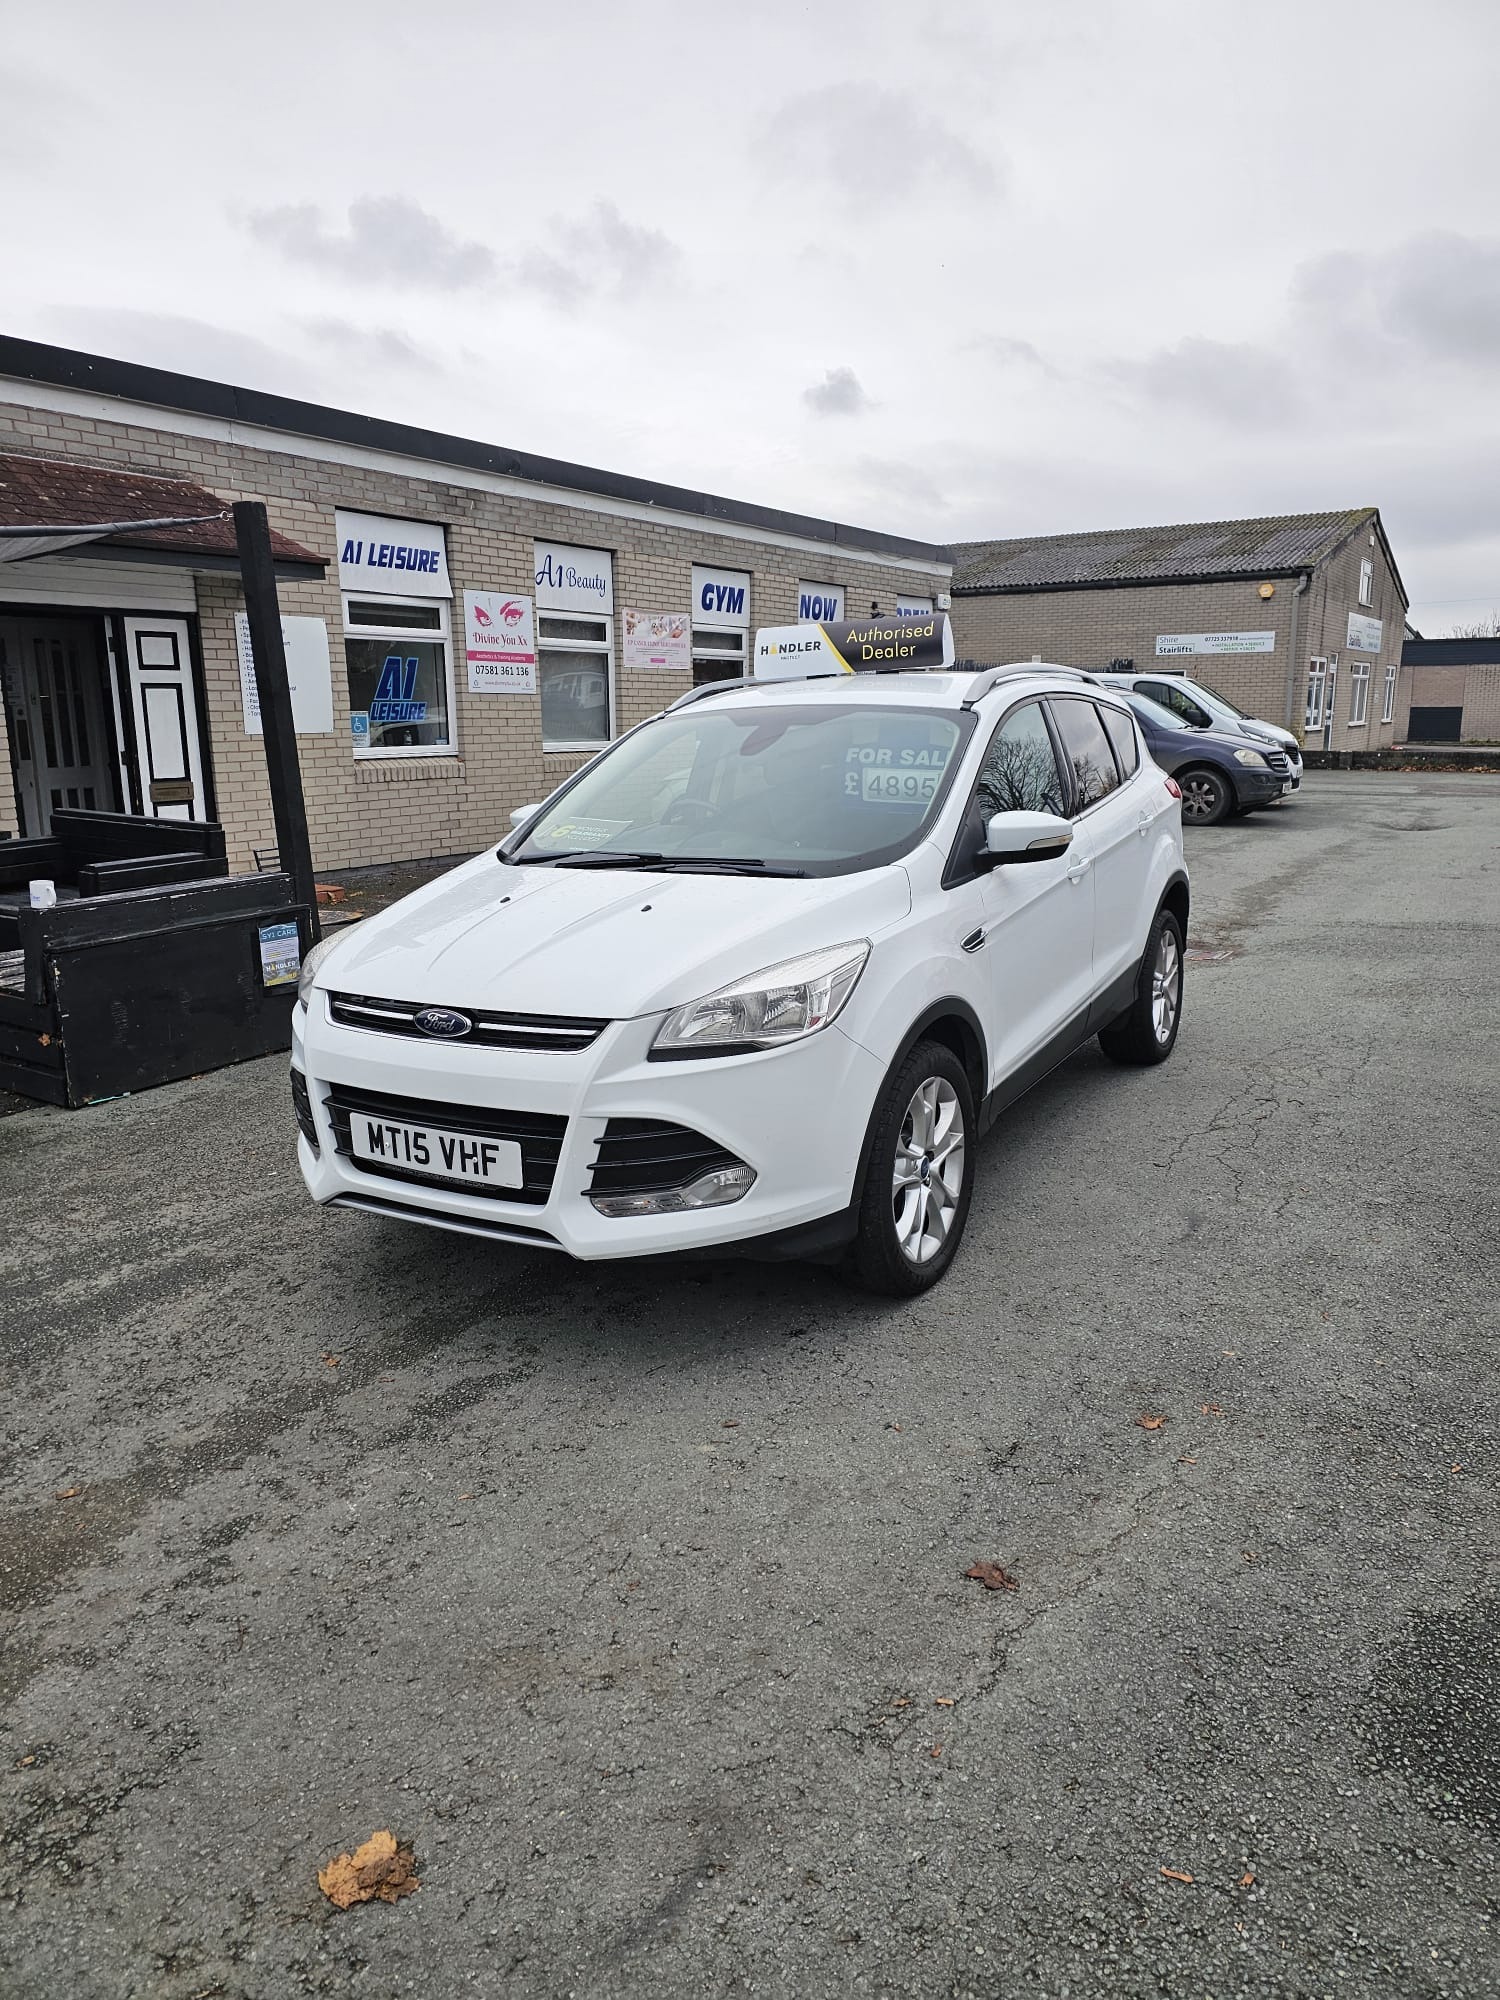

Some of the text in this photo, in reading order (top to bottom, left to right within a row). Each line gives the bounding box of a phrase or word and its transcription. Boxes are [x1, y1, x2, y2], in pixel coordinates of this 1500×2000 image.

[367, 542, 441, 574] LEISURE
[535, 554, 606, 598] A1 Beauty
[701, 583, 745, 614] GYM
[800, 594, 838, 622] NOW
[472, 632, 499, 645] Divine
[501, 633, 516, 648] You
[846, 620, 934, 644] Authorised
[1160, 636, 1179, 644] Shire
[862, 641, 916, 660] Dealer
[1159, 645, 1193, 653] Stairlifts
[374, 656, 419, 700] A1
[475, 665, 529, 676] 07581 361 136
[370, 702, 427, 721] LEISURE
[845, 747, 893, 764] FOR
[276, 928, 297, 937] CARS
[424, 1012, 456, 1032] Ford
[367, 1121, 430, 1165] MT15
[439, 1135, 500, 1176] VHF
